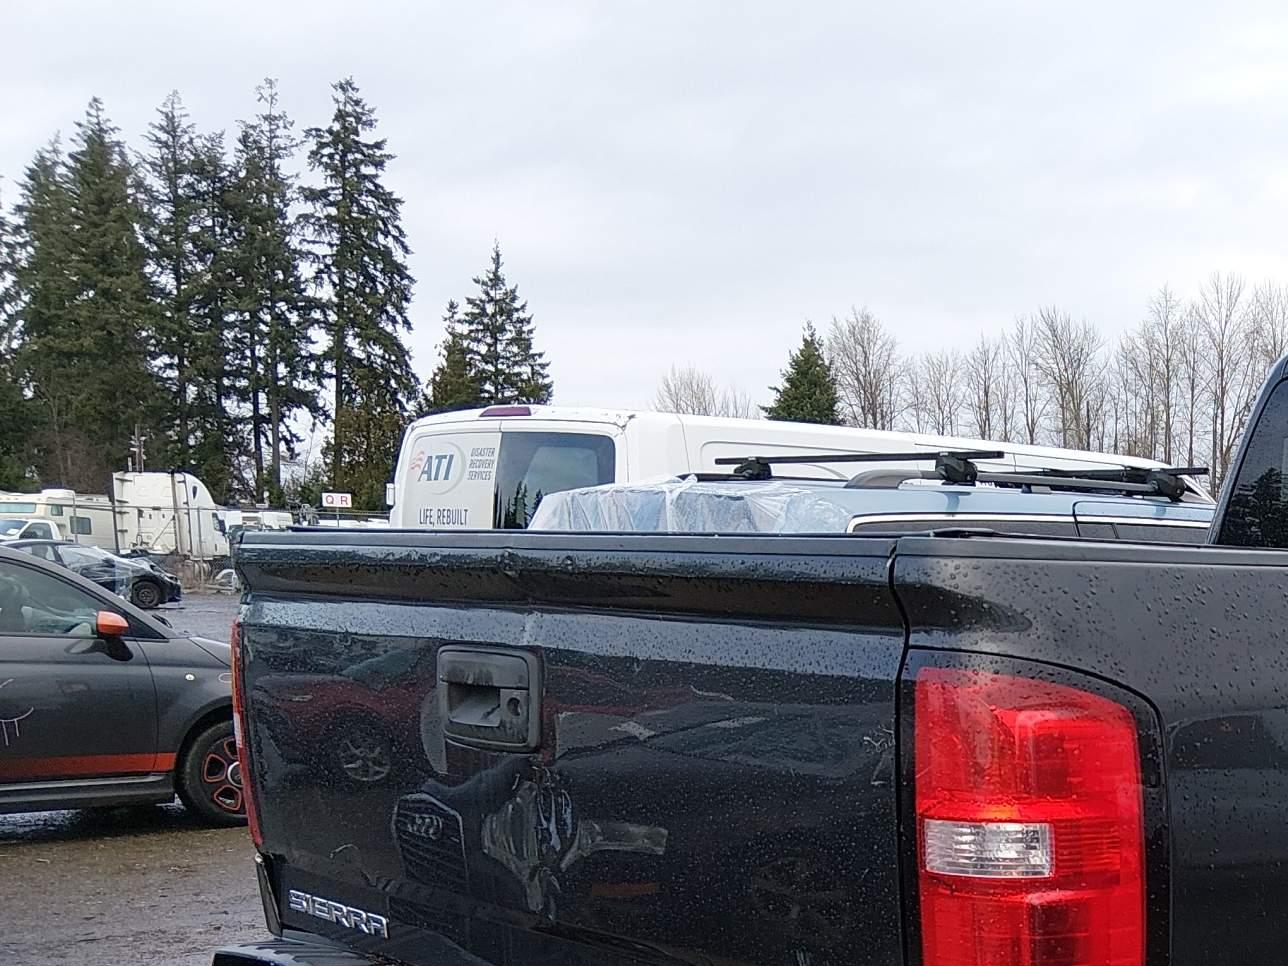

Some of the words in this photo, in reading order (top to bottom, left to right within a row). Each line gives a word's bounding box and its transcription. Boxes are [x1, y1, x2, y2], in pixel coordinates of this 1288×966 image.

[471, 448, 495, 457] DISASTER
[418, 455, 454, 481] ATI
[468, 459, 495, 469] RECOVERY
[467, 471, 492, 481] SERVICES
[325, 495, 335, 505] Q
[340, 495, 348, 505] R
[419, 508, 435, 527] LIFE,
[436, 508, 469, 526] REBUILT
[289, 889, 388, 939] SIERRA
